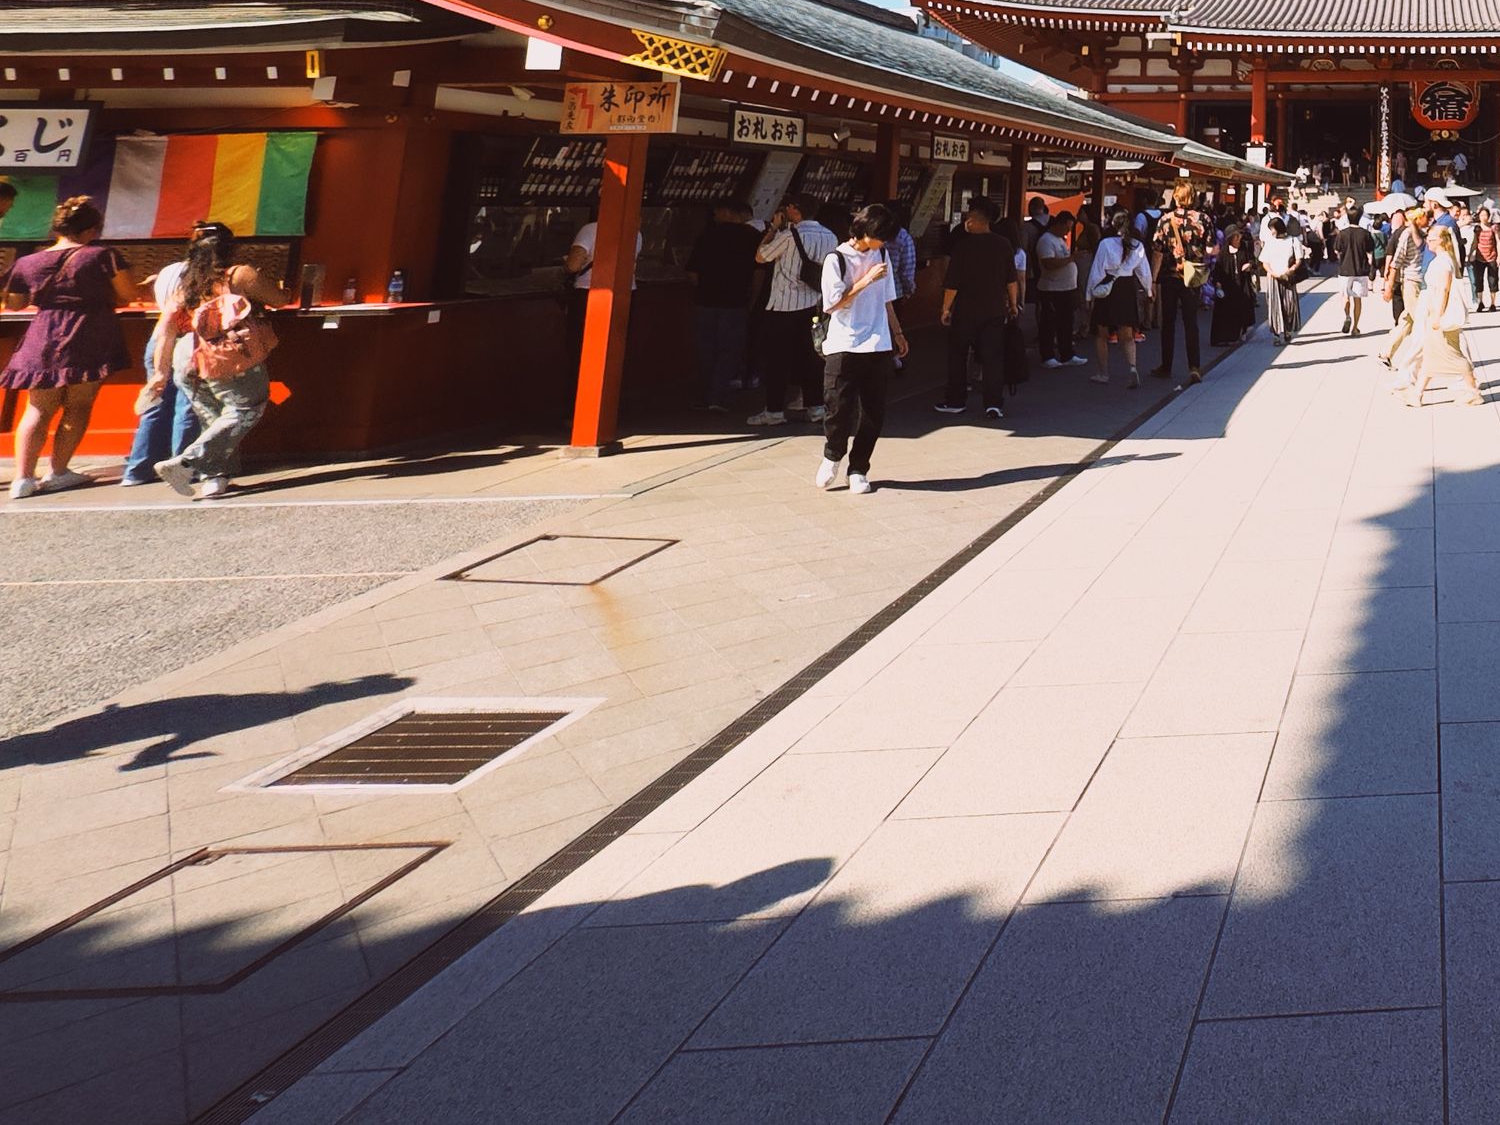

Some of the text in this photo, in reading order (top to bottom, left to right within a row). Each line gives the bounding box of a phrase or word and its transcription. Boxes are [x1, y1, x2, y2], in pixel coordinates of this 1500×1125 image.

[599, 84, 671, 114] 朱印所
[737, 115, 798, 143] お札お守
